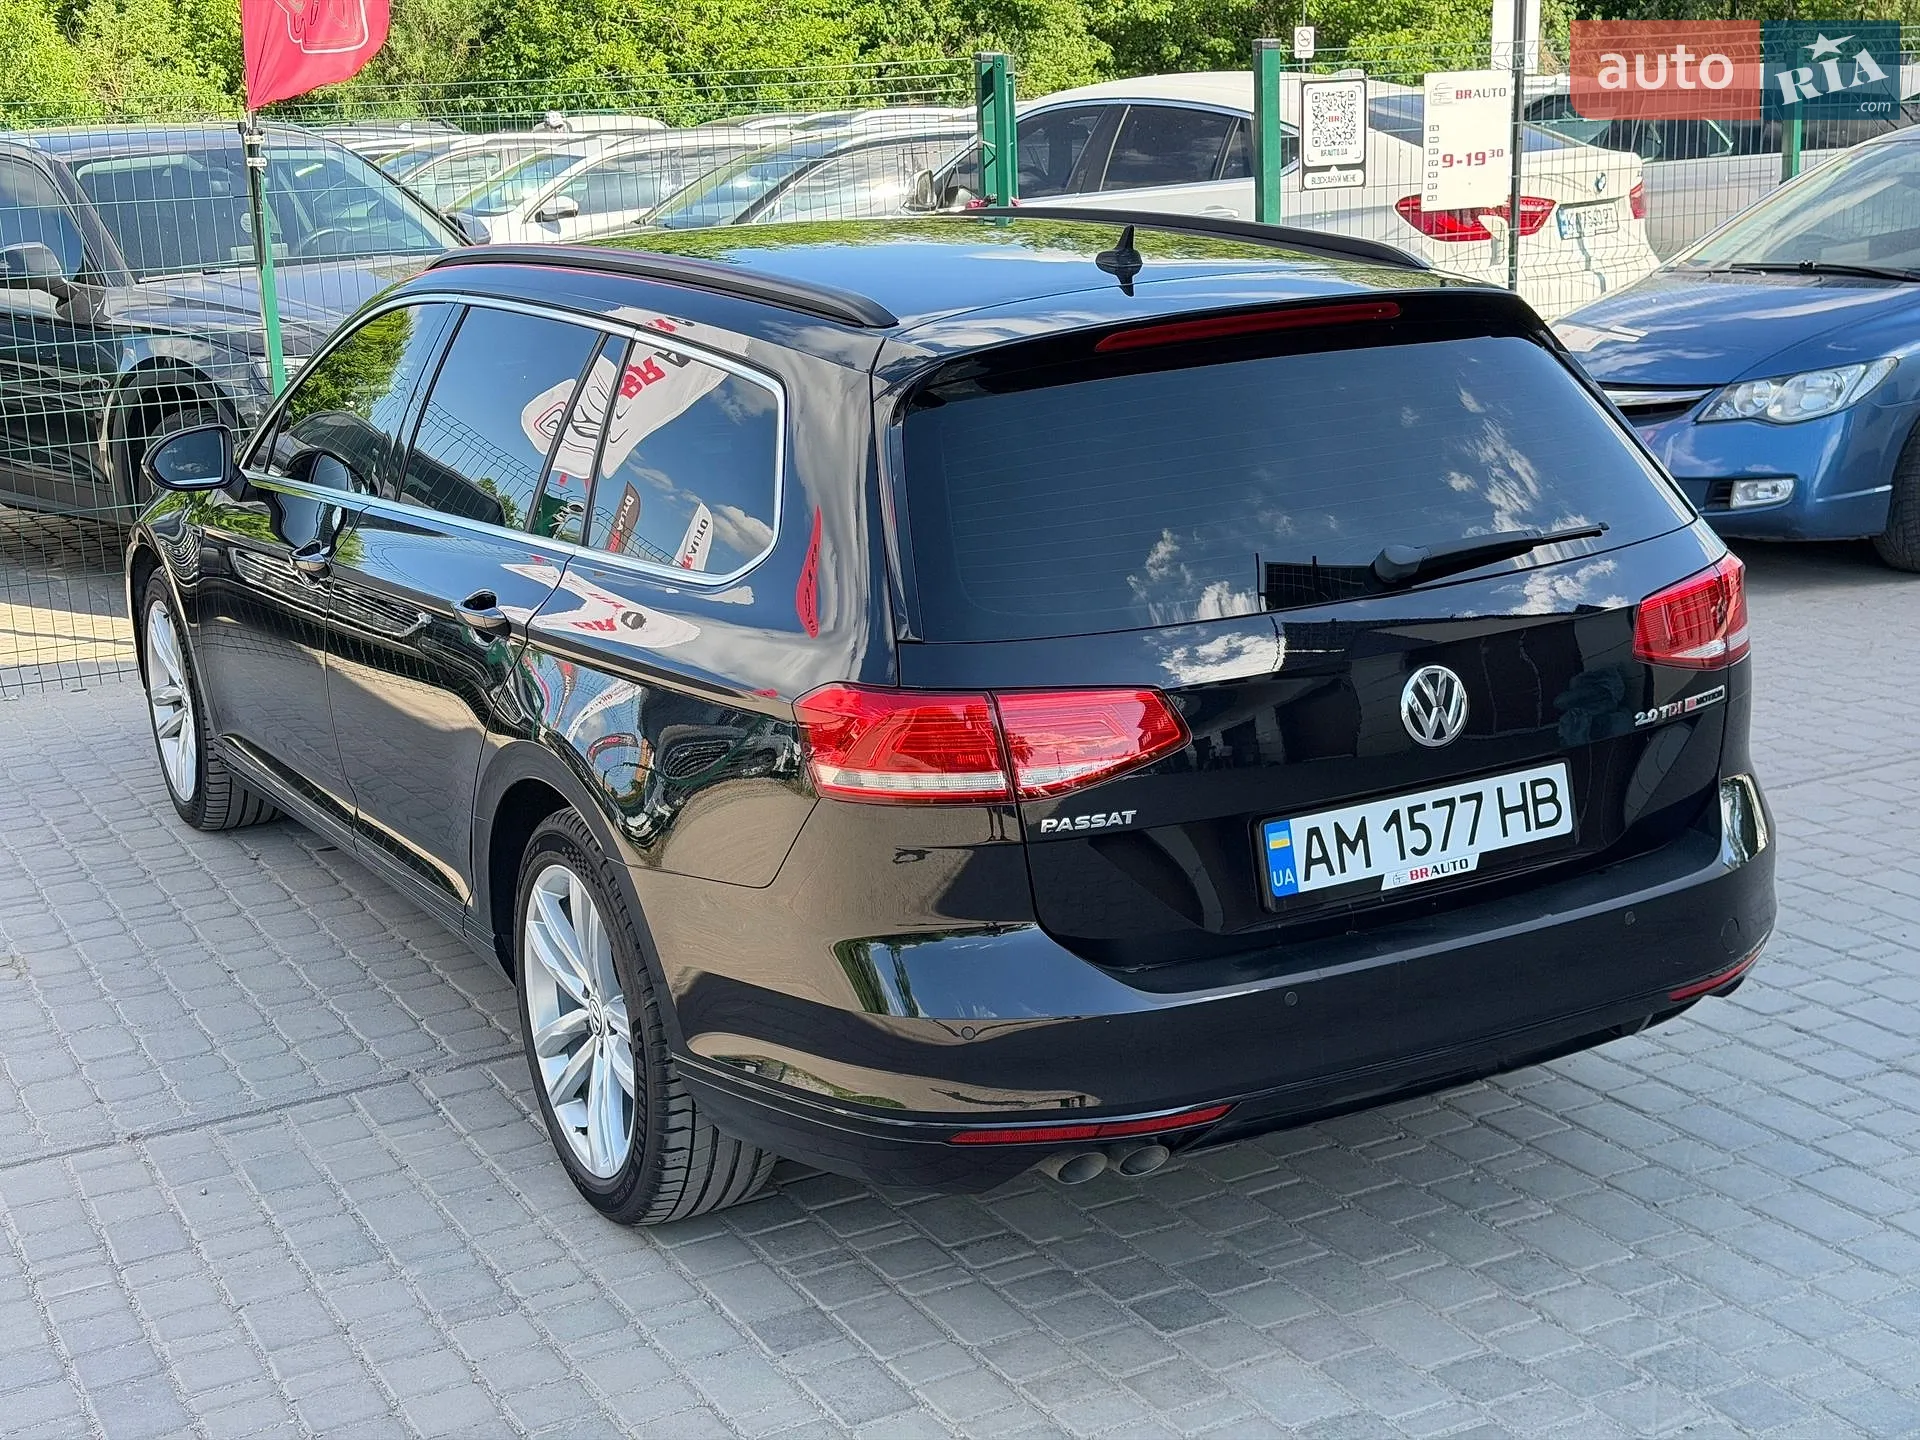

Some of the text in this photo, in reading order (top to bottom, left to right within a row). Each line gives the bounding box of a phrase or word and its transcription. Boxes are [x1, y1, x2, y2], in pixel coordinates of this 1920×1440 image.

[1455, 87, 1507, 100] BRAUTO
[1658, 700, 1684, 719] TDI
[1040, 809, 1137, 833] PASSAT
[1272, 776, 1563, 888] UA AM 1577 HB
[1408, 857, 1470, 882] BRAUTO
